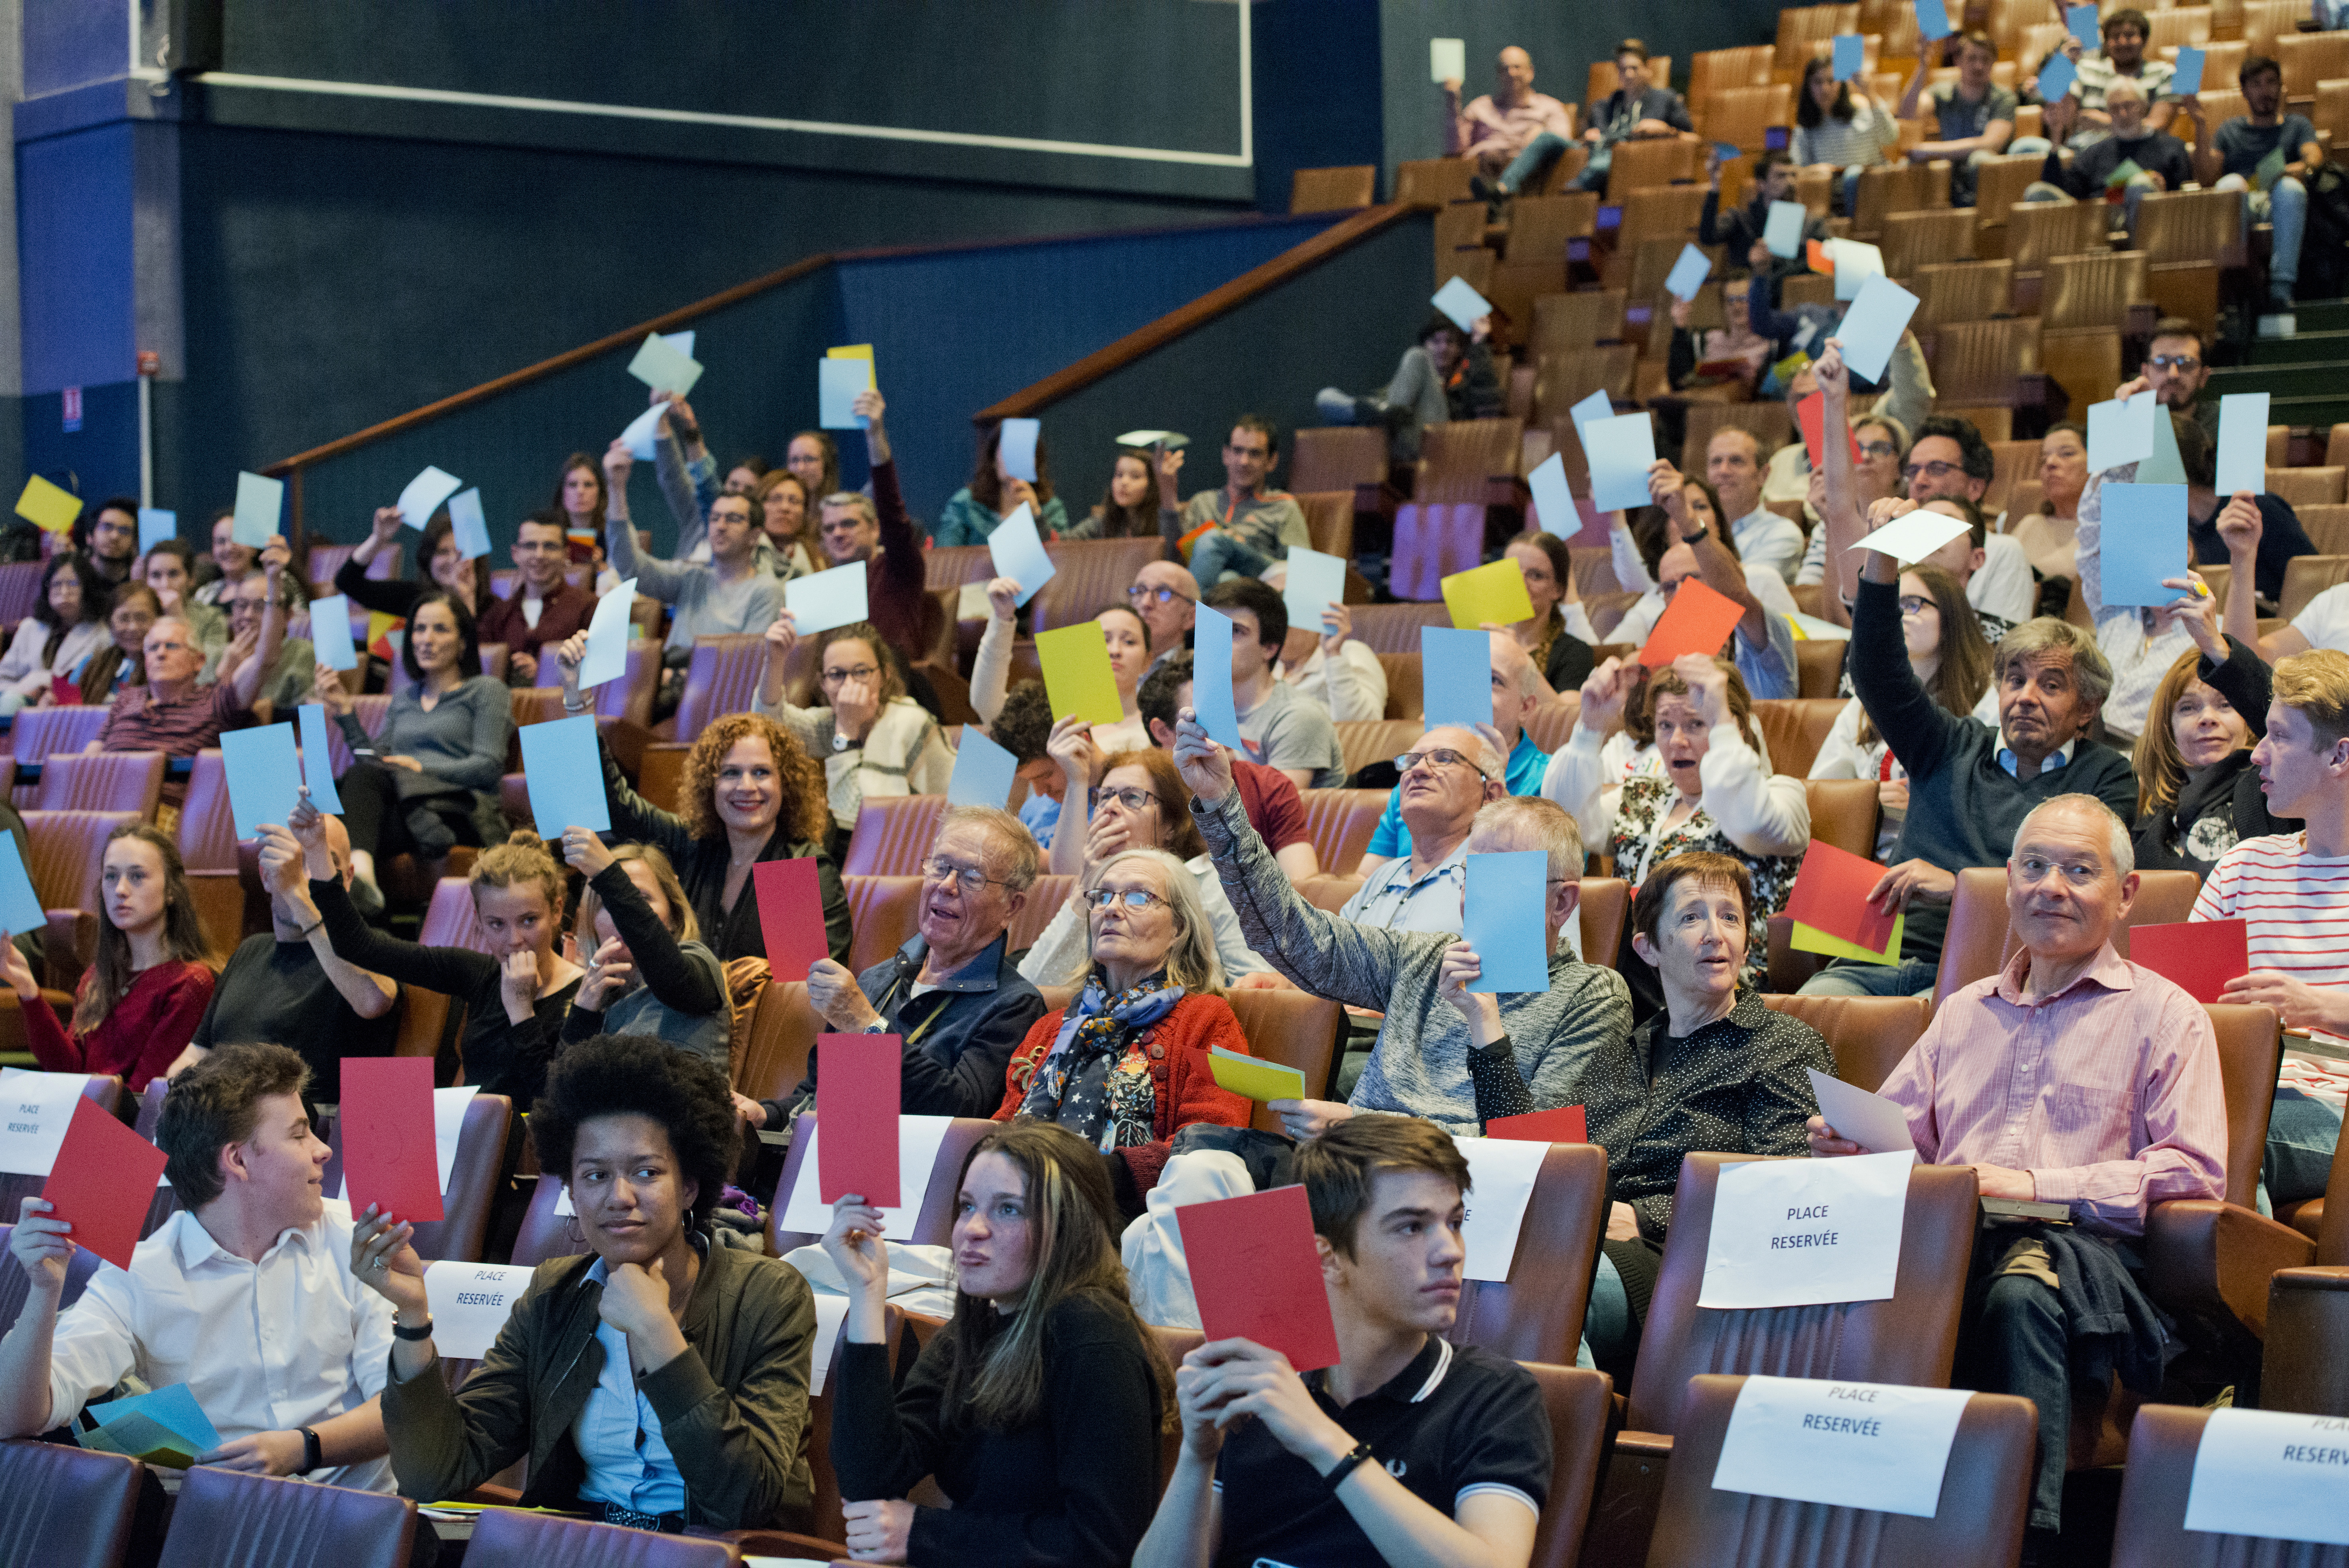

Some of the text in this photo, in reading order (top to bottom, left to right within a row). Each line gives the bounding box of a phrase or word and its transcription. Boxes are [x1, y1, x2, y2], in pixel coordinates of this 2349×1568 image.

[1787, 1205, 1829, 1220] PLACE
[1771, 1229, 1838, 1249] RESERVÉE
[474, 1270, 507, 1281] PLACE
[456, 1292, 504, 1306] RESERVÉE
[1828, 1386, 1879, 1403] PLACE
[1803, 1413, 1881, 1436] RESERVÉE
[2312, 1420, 2349, 1431] PLA
